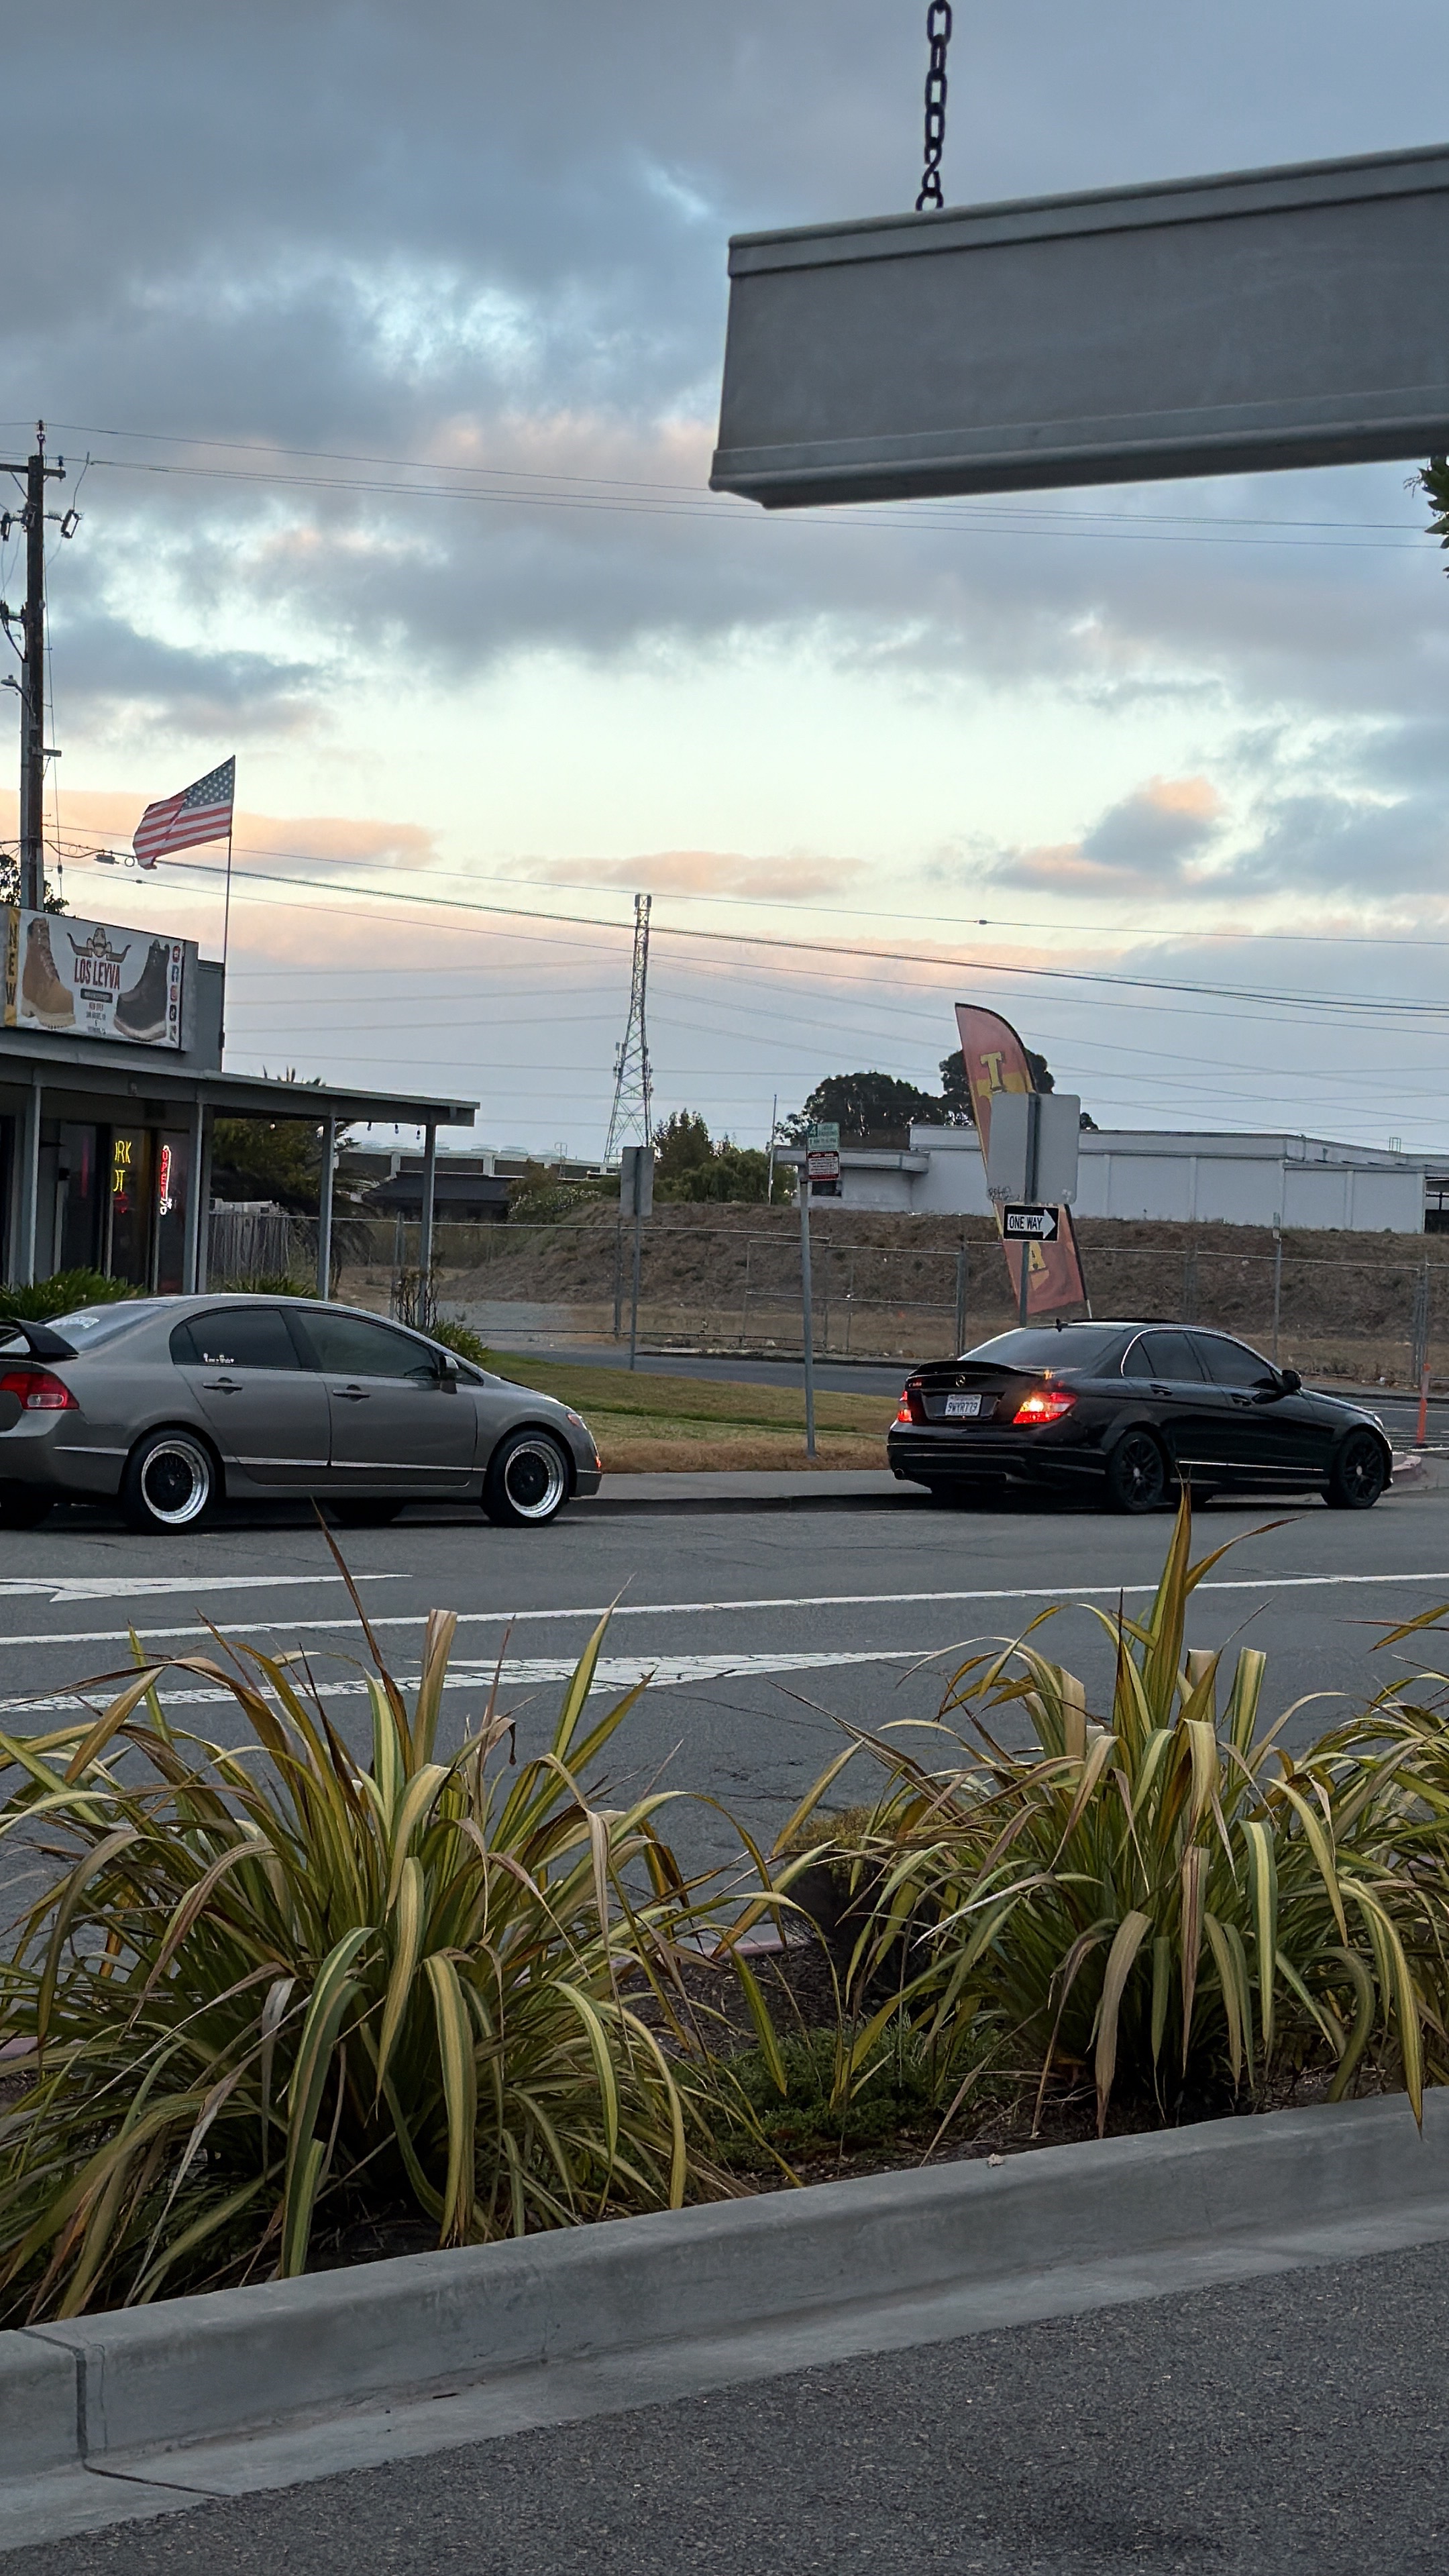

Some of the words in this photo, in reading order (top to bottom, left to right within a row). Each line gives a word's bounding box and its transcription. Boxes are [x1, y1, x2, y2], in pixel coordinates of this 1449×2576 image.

[5, 923, 17, 1006] NEW
[74, 958, 91, 985] LOS
[93, 961, 120, 990] LEYVA
[1009, 1216, 1024, 1229] ONE
[1026, 1216, 1043, 1230] WAY
